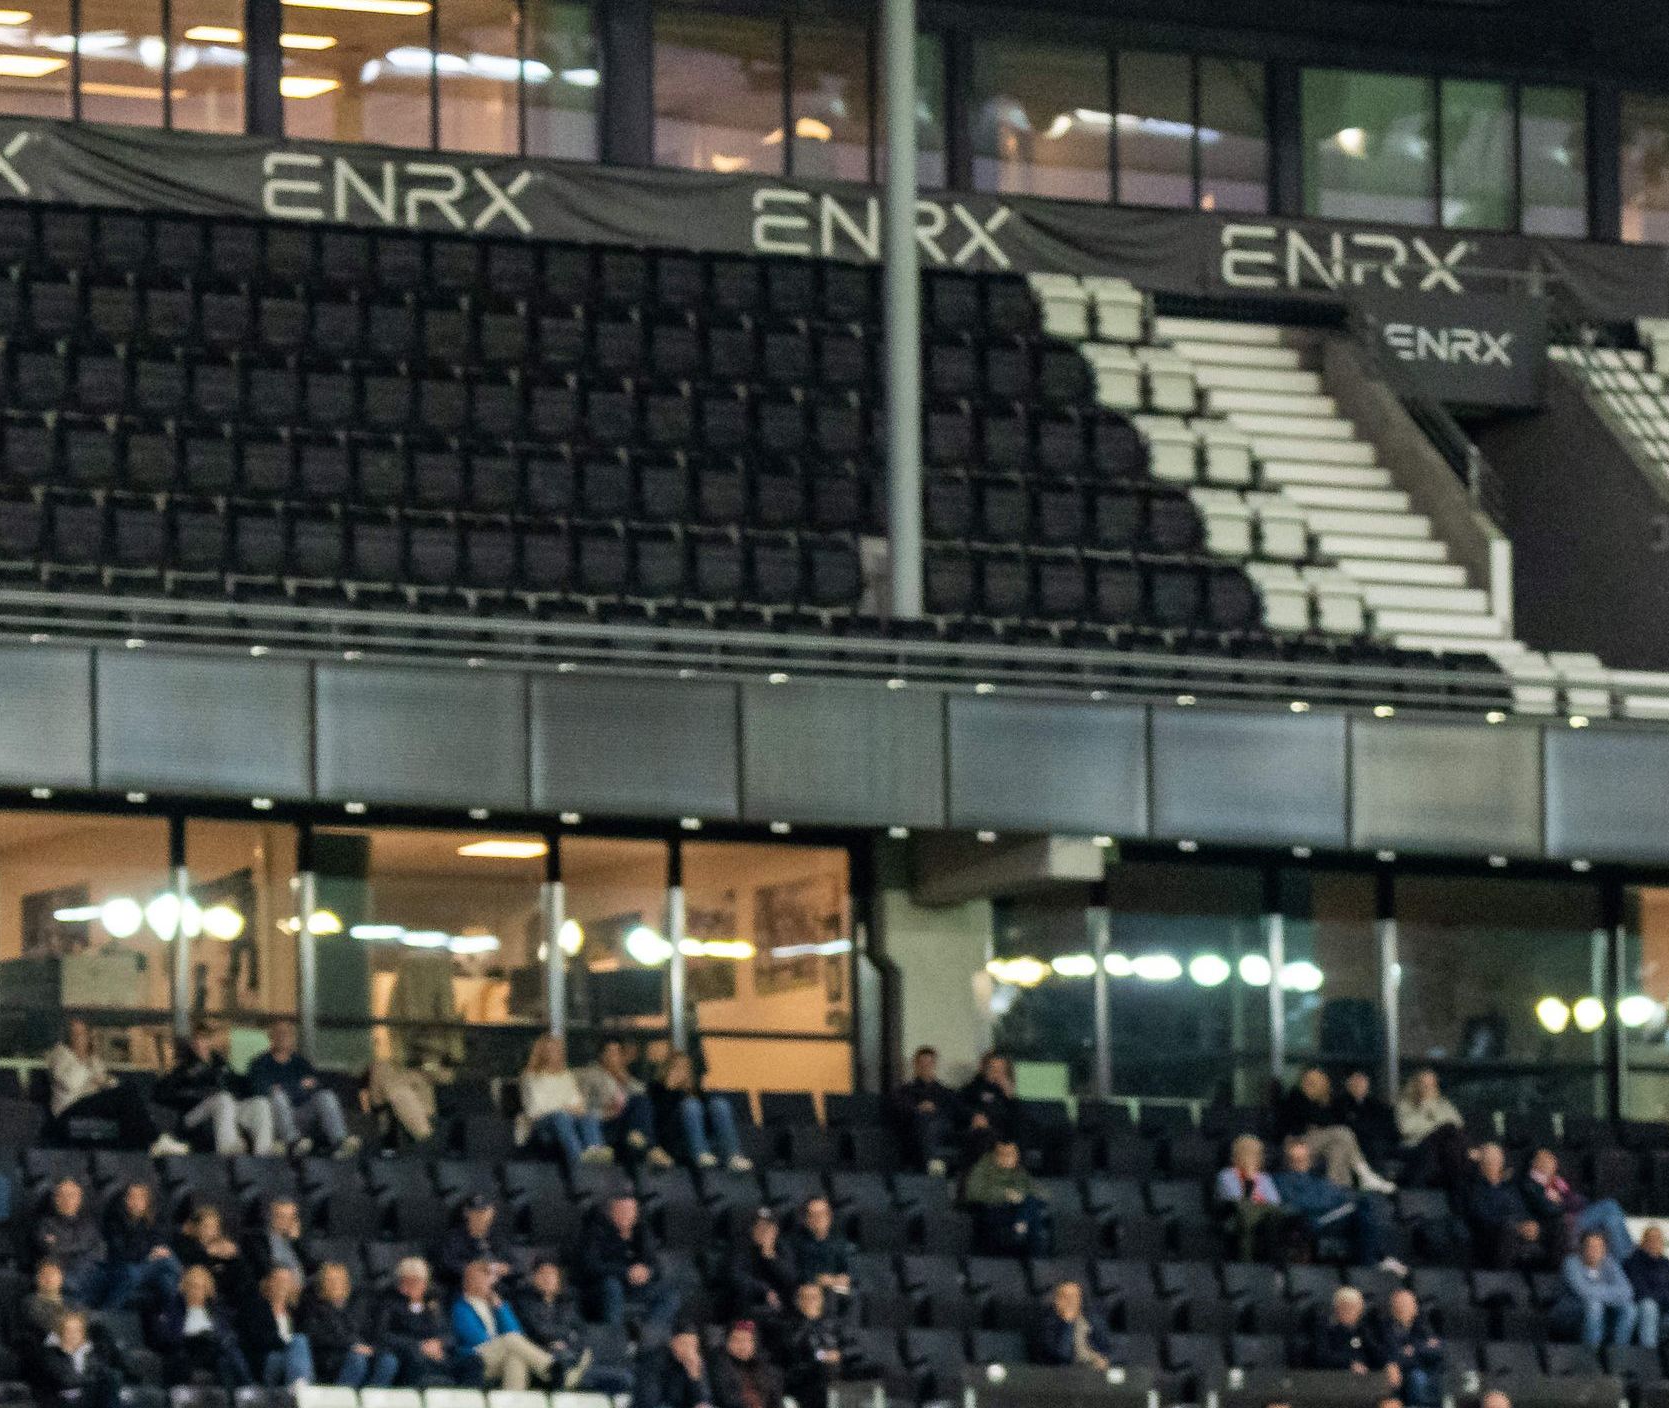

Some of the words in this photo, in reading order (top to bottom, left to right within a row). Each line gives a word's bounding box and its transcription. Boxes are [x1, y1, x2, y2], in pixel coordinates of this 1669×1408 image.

[262, 151, 533, 233] ENRX
[752, 188, 1012, 270] ENRX
[1220, 223, 1466, 293] ENRX
[1385, 323, 1514, 368] ENRX
